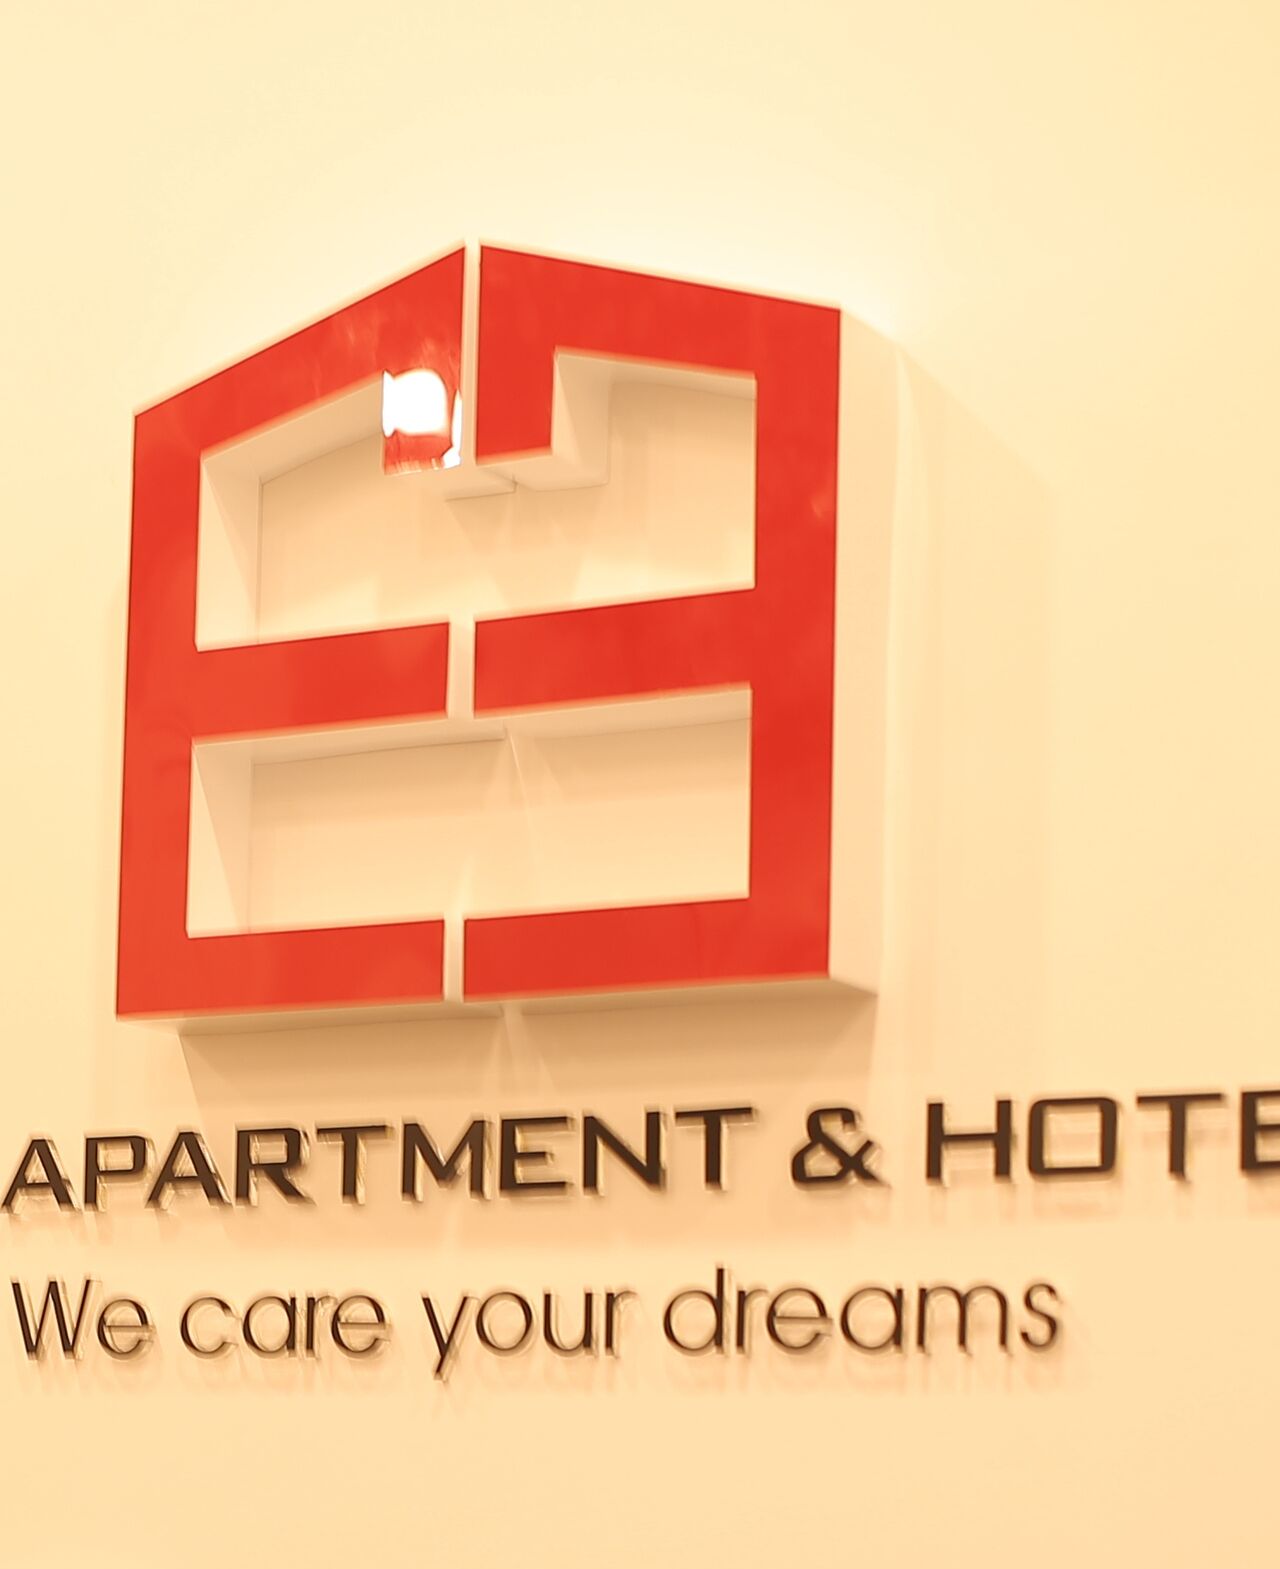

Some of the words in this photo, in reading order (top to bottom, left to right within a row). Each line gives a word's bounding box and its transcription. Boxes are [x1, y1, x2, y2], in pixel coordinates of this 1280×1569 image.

[1, 1106, 757, 1212] APARTMENT
[791, 1107, 883, 1190] &
[11, 1279, 150, 1358] We
[180, 1295, 386, 1357] care
[422, 1291, 632, 1377] your
[663, 1267, 1058, 1354] dreams
